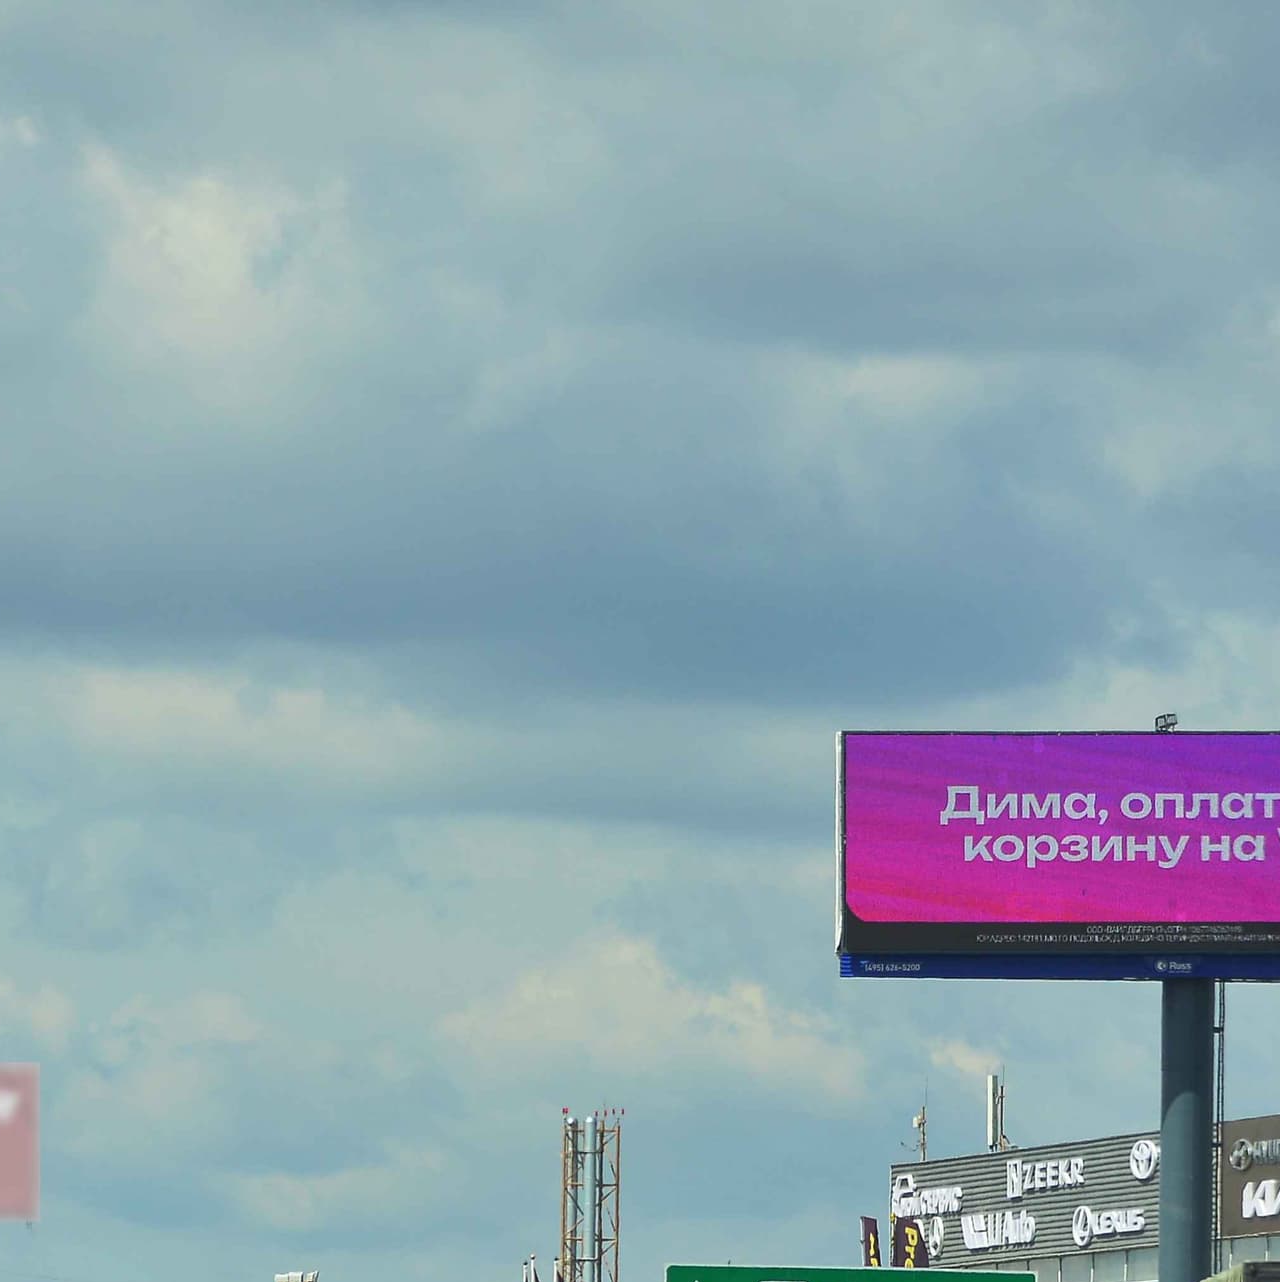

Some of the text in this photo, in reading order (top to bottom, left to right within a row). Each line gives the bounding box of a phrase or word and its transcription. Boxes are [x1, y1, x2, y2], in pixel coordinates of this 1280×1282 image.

[940, 785, 1107, 826] Дима,
[964, 833, 1188, 868] корзину
[1200, 834, 1264, 861] на
[1023, 1158, 1084, 1190] ZEEKR
